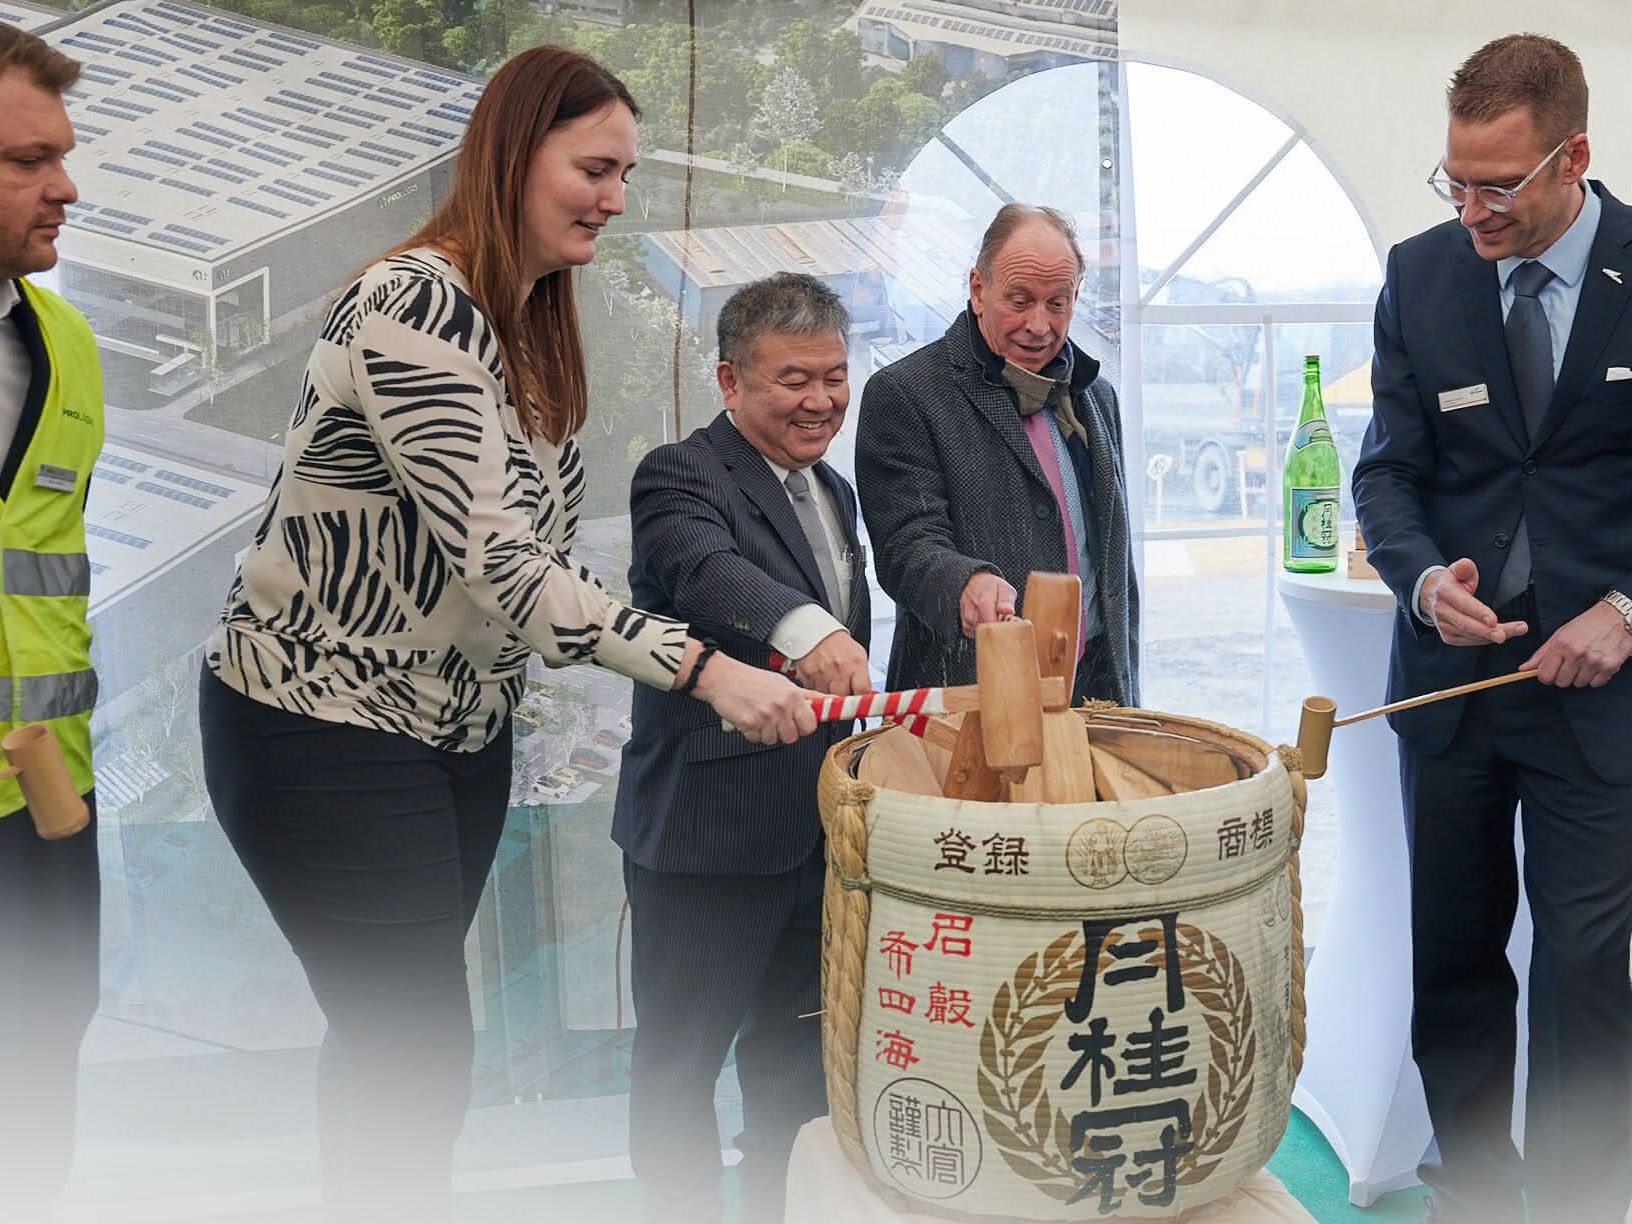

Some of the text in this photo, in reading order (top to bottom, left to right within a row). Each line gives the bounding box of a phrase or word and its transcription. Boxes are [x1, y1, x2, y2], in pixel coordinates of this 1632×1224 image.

[933, 827, 1029, 876] 登録
[1217, 808, 1273, 860] 商標
[1060, 912, 1198, 1215] 月桂冠
